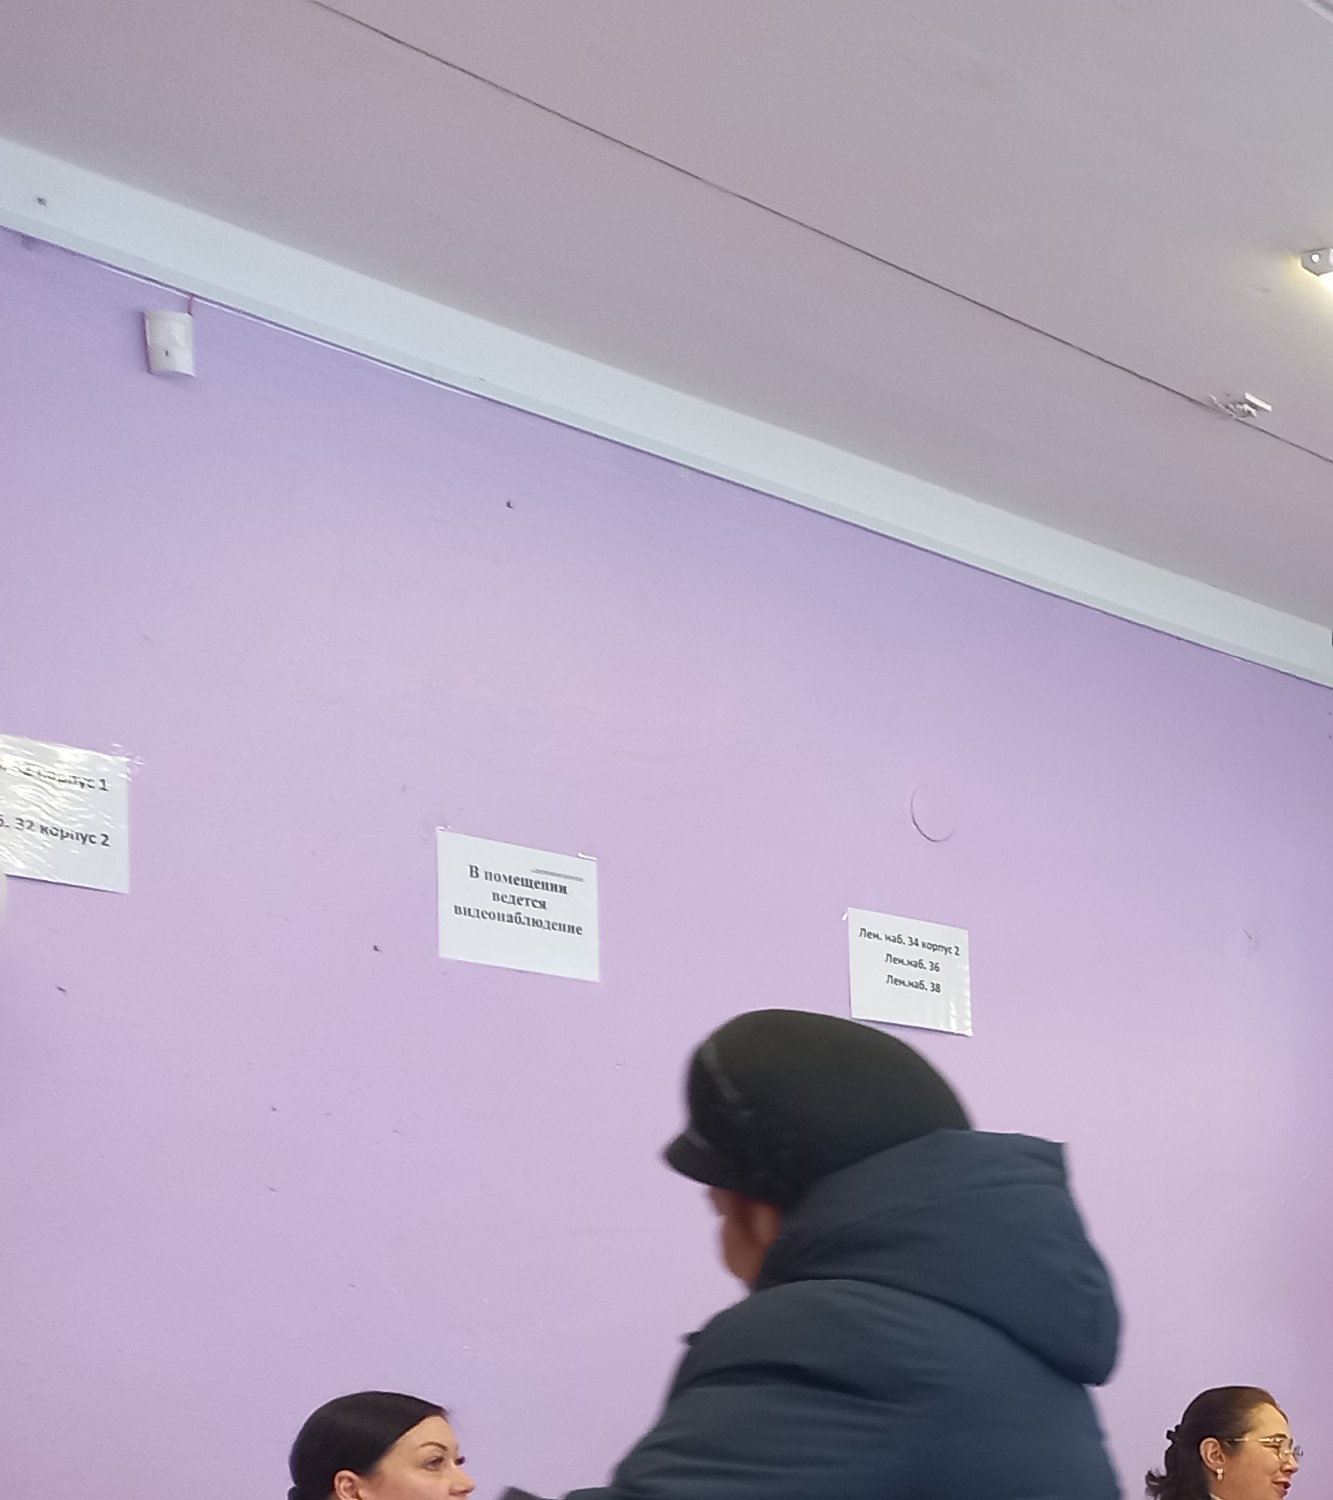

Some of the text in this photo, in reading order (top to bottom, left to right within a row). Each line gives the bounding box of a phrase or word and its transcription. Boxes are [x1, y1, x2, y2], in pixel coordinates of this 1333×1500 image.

[98, 778, 109, 792] 1
[15, 817, 36, 831] 32
[39, 824, 97, 845] корпус
[100, 833, 111, 848] 2
[468, 864, 568, 895] В помещении
[491, 891, 548, 910] ведется
[453, 904, 583, 936] видеонаблюдение
[859, 927, 961, 956] Лен. наб. 34 корпус 2
[928, 961, 941, 972] 36
[930, 982, 942, 993] 38
